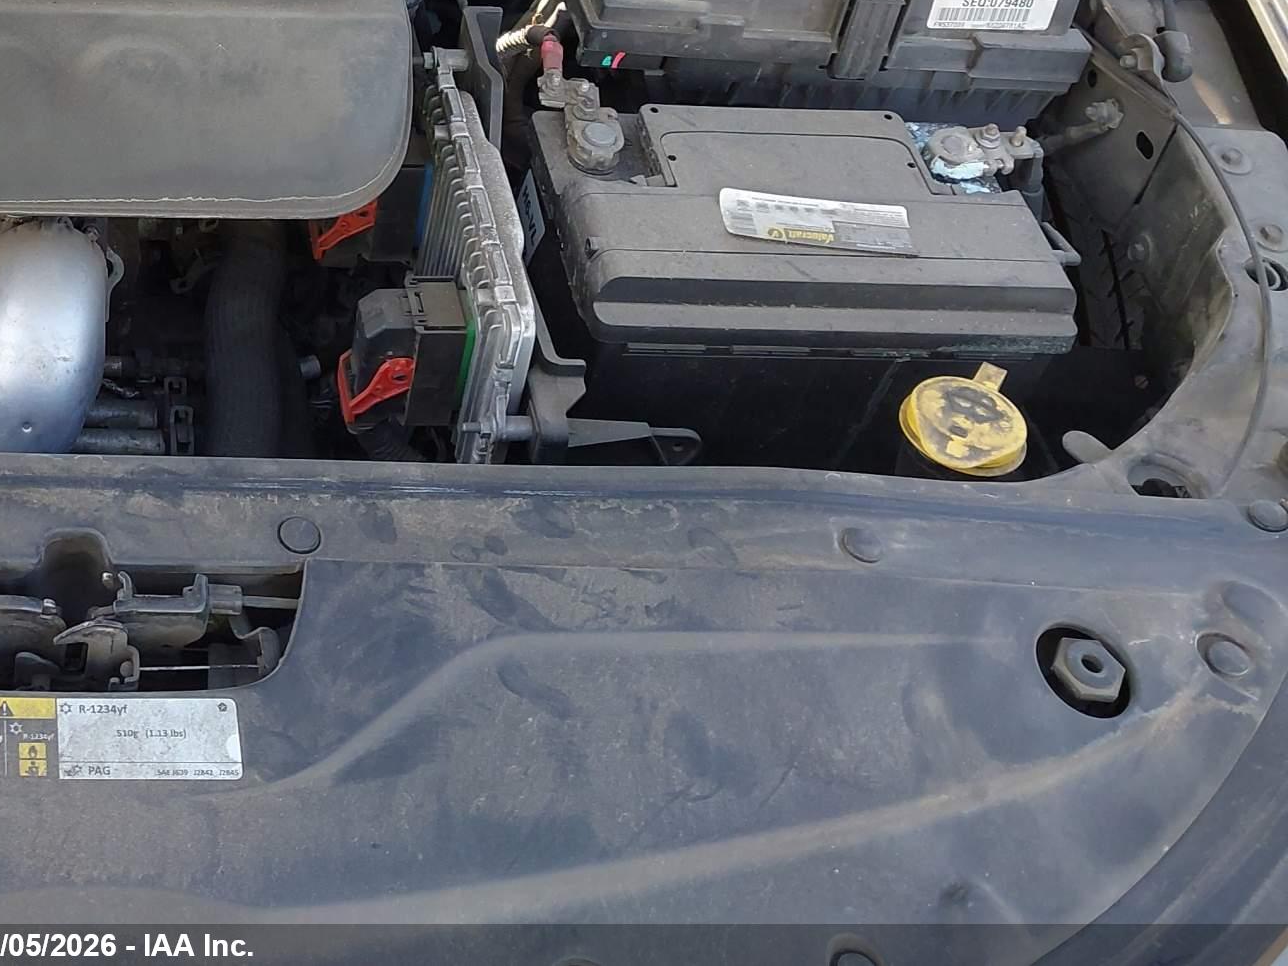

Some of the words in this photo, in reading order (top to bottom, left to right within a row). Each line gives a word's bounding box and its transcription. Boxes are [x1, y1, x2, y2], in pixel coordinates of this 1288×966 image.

[79, 704, 128, 716] R-1234yf
[116, 729, 139, 739] 510g
[145, 729, 168, 739] (1.13
[170, 729, 187, 739] lbs)
[88, 765, 111, 776] PAG
